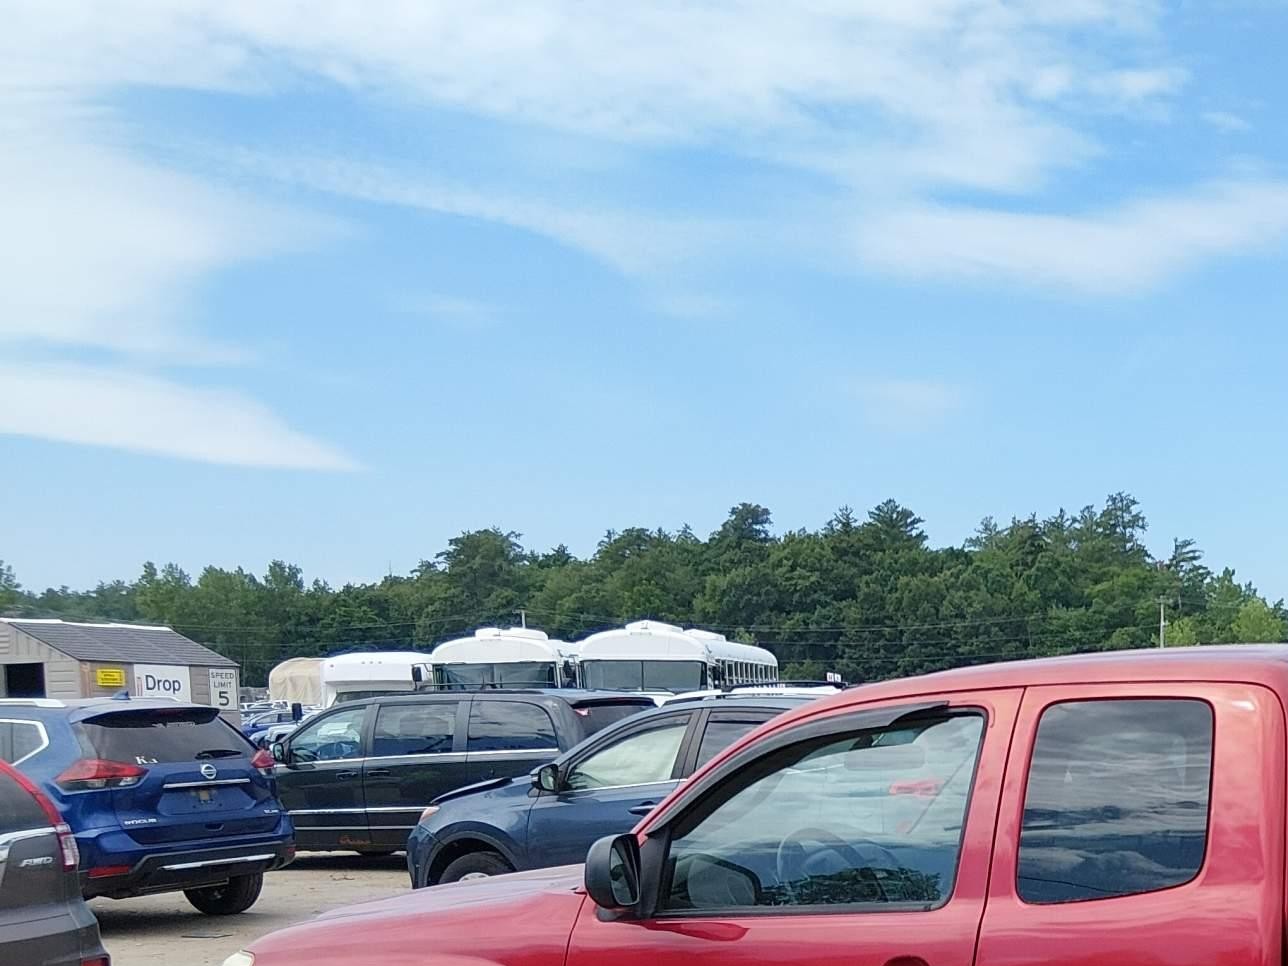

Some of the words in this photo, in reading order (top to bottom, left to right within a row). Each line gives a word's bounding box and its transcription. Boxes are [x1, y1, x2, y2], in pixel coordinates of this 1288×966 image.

[210, 672, 234, 680] SPEED
[145, 675, 181, 694] Drop
[213, 681, 232, 689] LIMIT
[218, 691, 230, 706] 5
[19, 856, 54, 868] AWD
